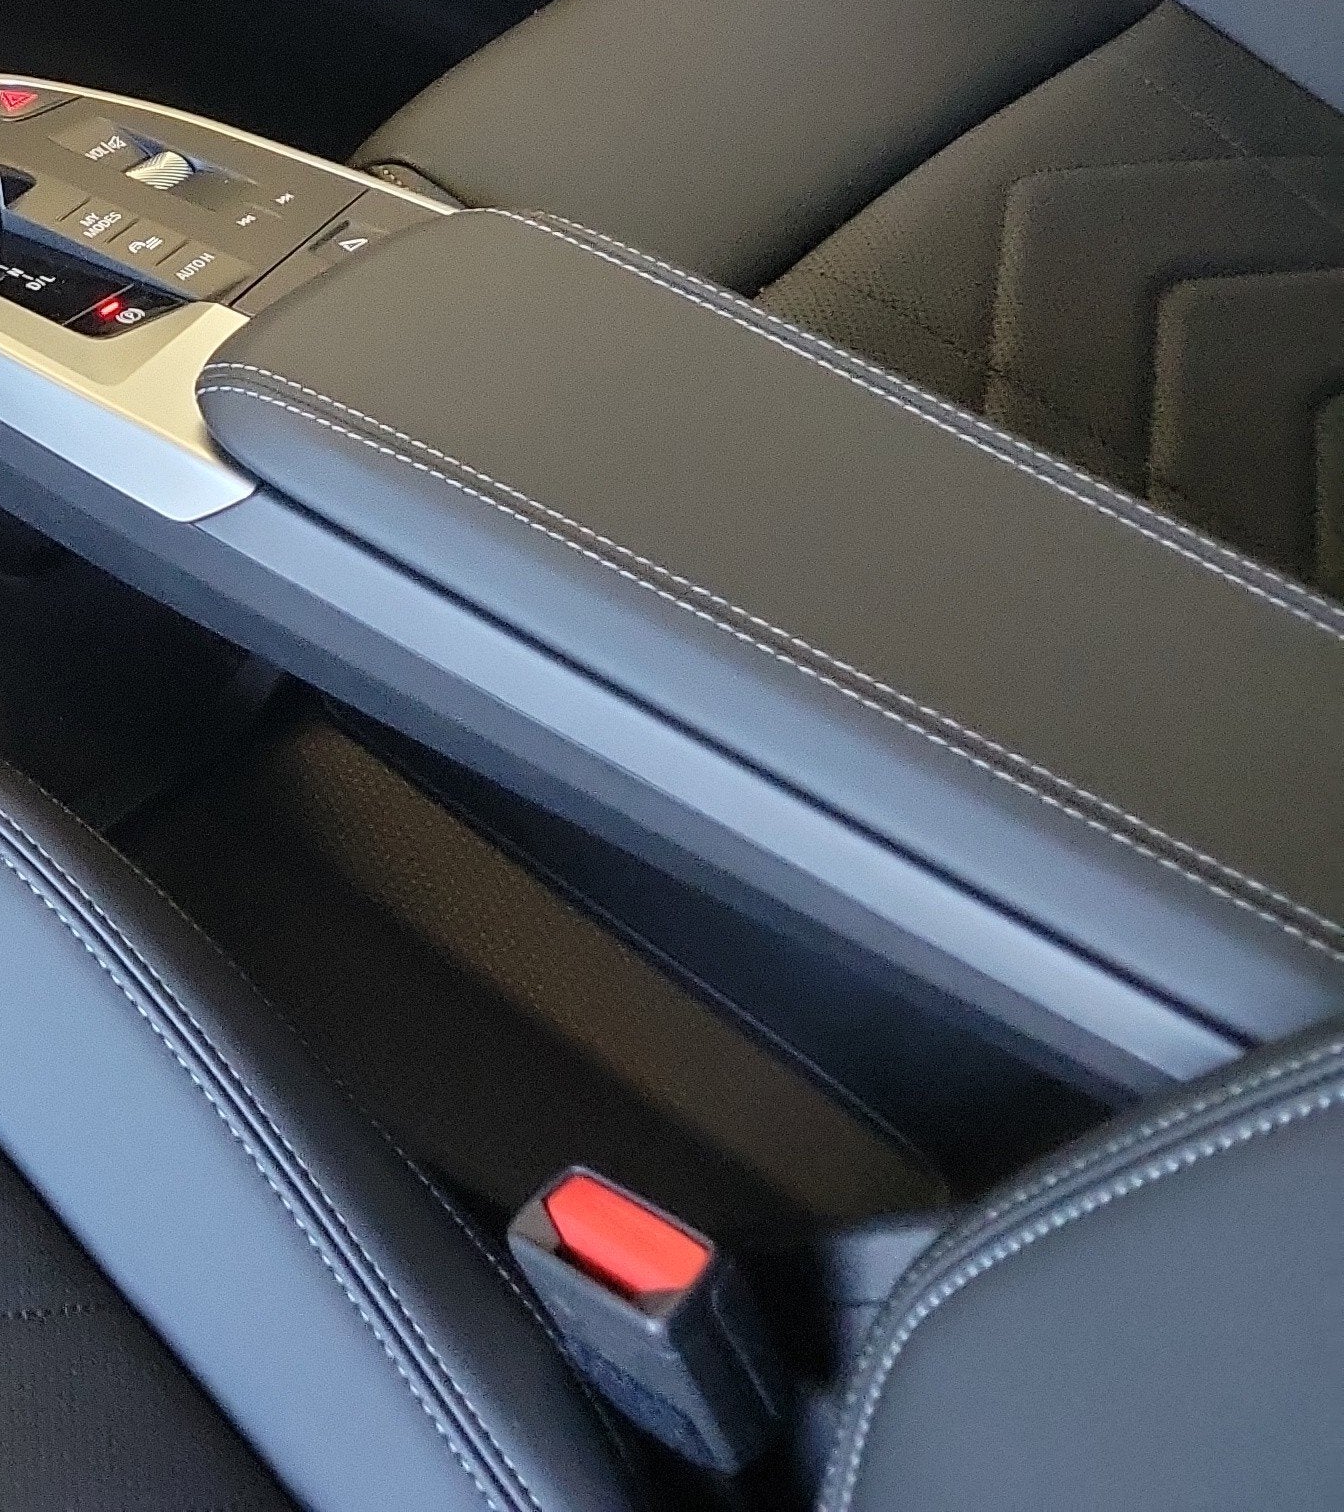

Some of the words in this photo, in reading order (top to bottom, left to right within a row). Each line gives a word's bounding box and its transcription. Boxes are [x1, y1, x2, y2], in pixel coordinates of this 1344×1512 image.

[80, 212, 99, 227] MY
[83, 211, 122, 238] MODES
[175, 258, 205, 281] AUTO
[204, 252, 215, 263] H
